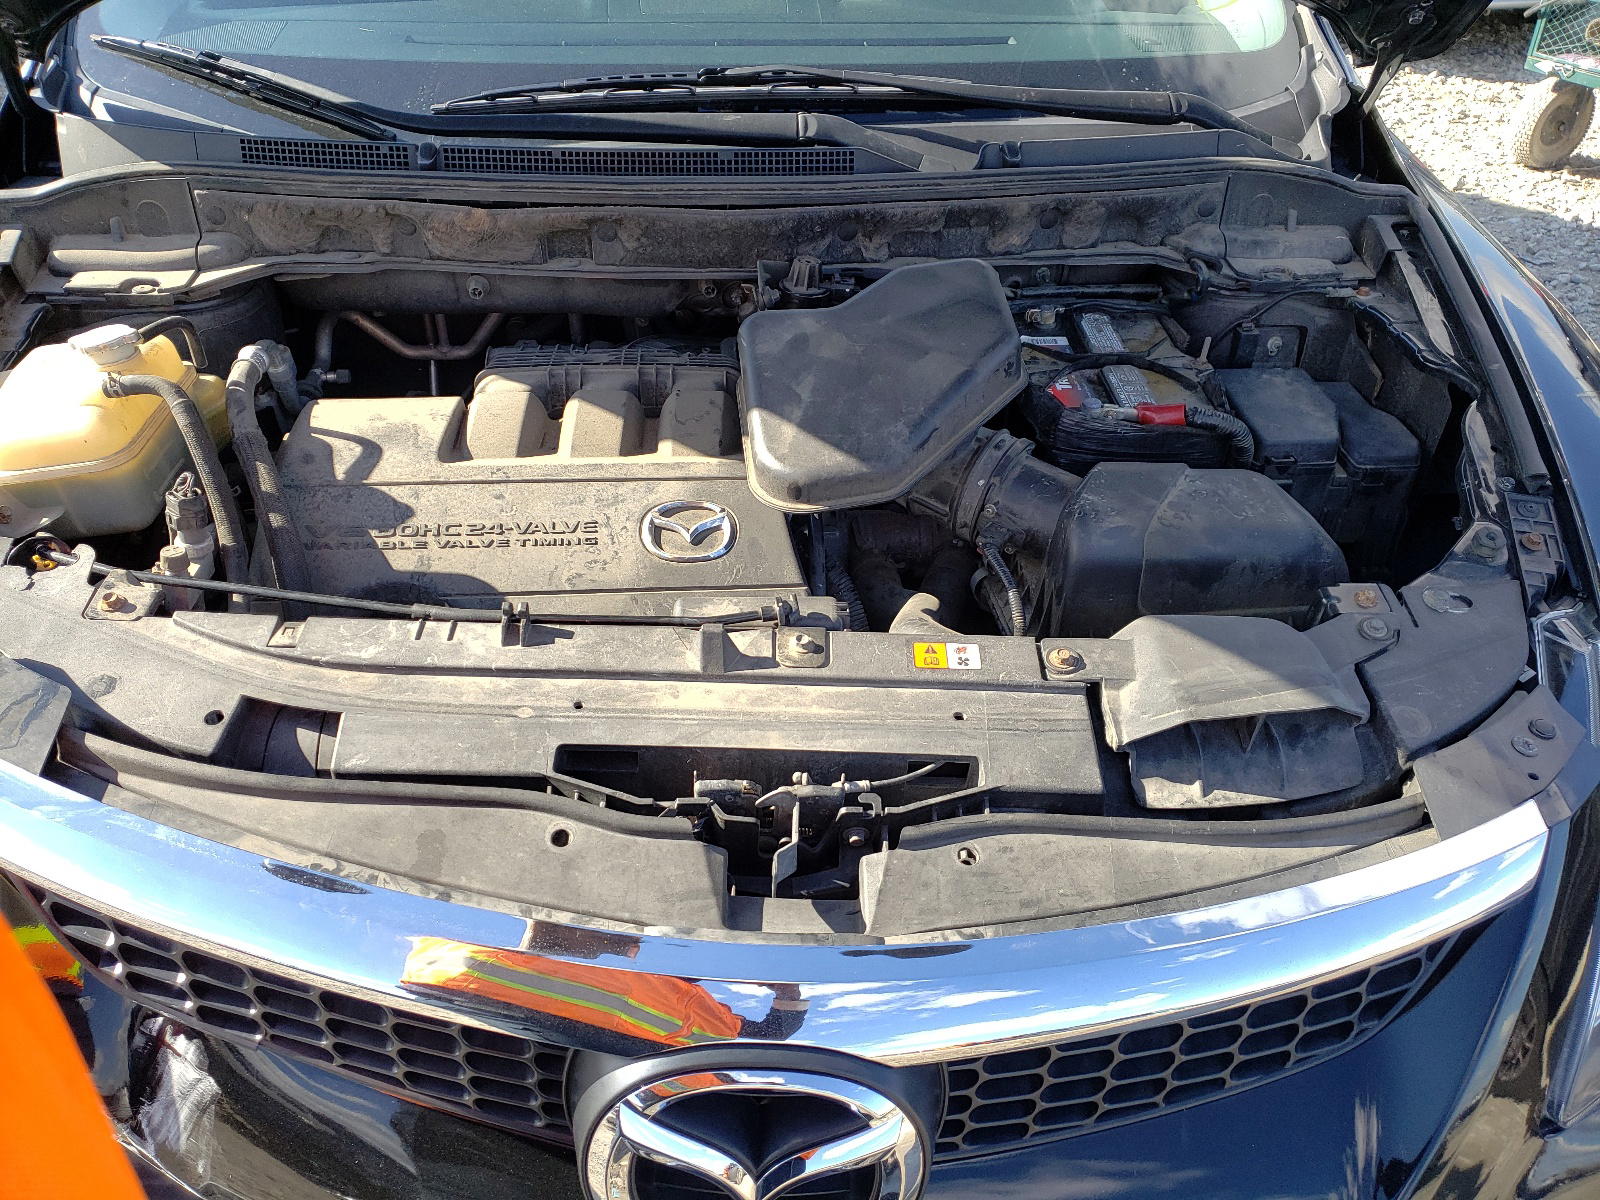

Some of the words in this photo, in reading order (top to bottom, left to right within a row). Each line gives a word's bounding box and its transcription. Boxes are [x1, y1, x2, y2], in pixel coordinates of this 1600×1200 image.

[369, 522, 463, 538] DOHC
[465, 519, 600, 536] 24-VALVE
[303, 540, 429, 551] VARIABLE
[435, 537, 511, 549] VALVE
[515, 535, 600, 547] TIMING
